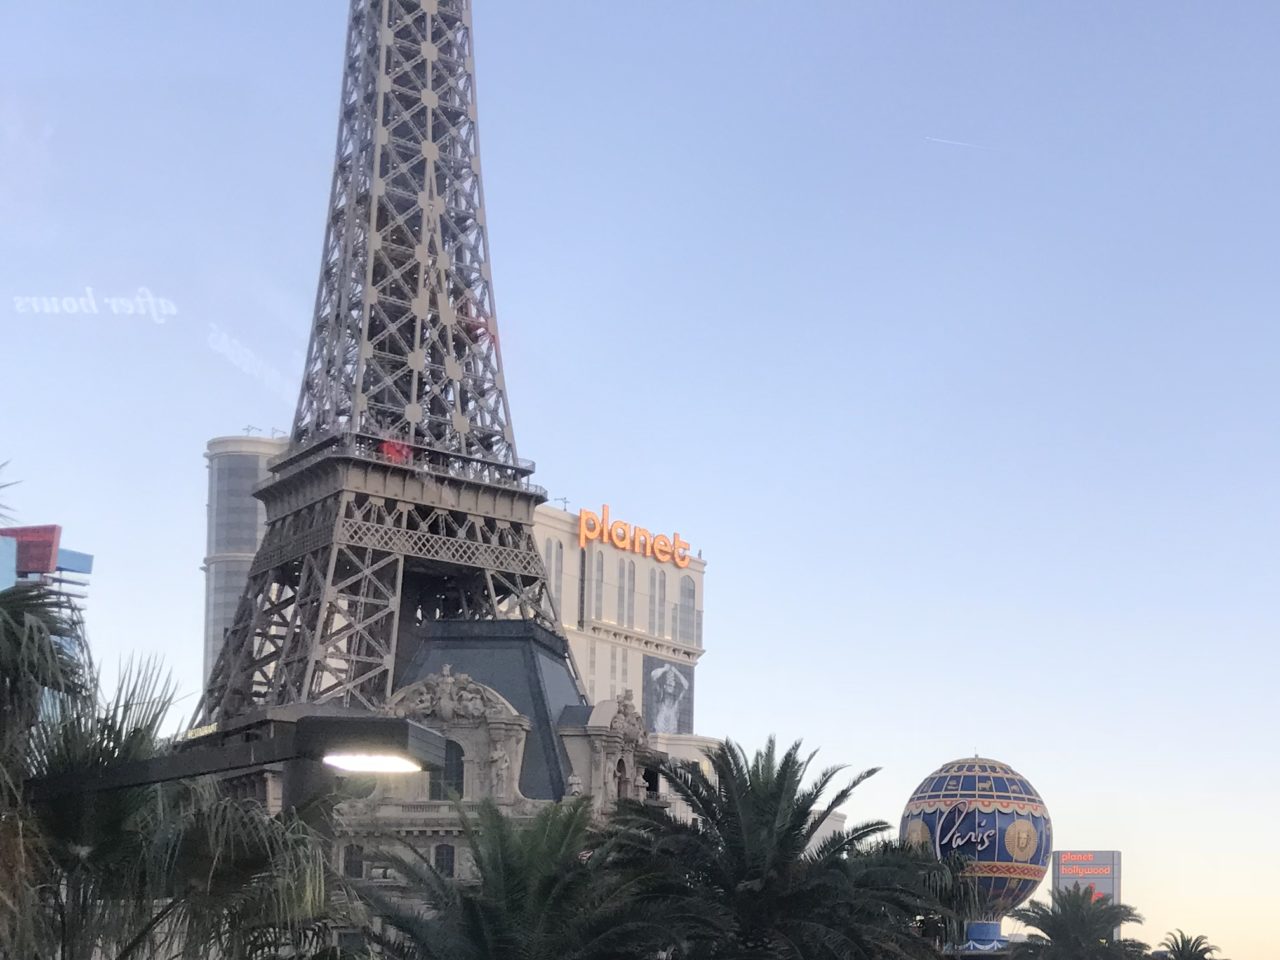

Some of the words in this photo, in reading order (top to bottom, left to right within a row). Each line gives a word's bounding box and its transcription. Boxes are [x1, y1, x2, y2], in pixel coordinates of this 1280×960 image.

[578, 504, 691, 568] planet
[937, 800, 995, 863] Paris
[1060, 852, 1094, 864] planet
[1060, 865, 1111, 877] hollywood
